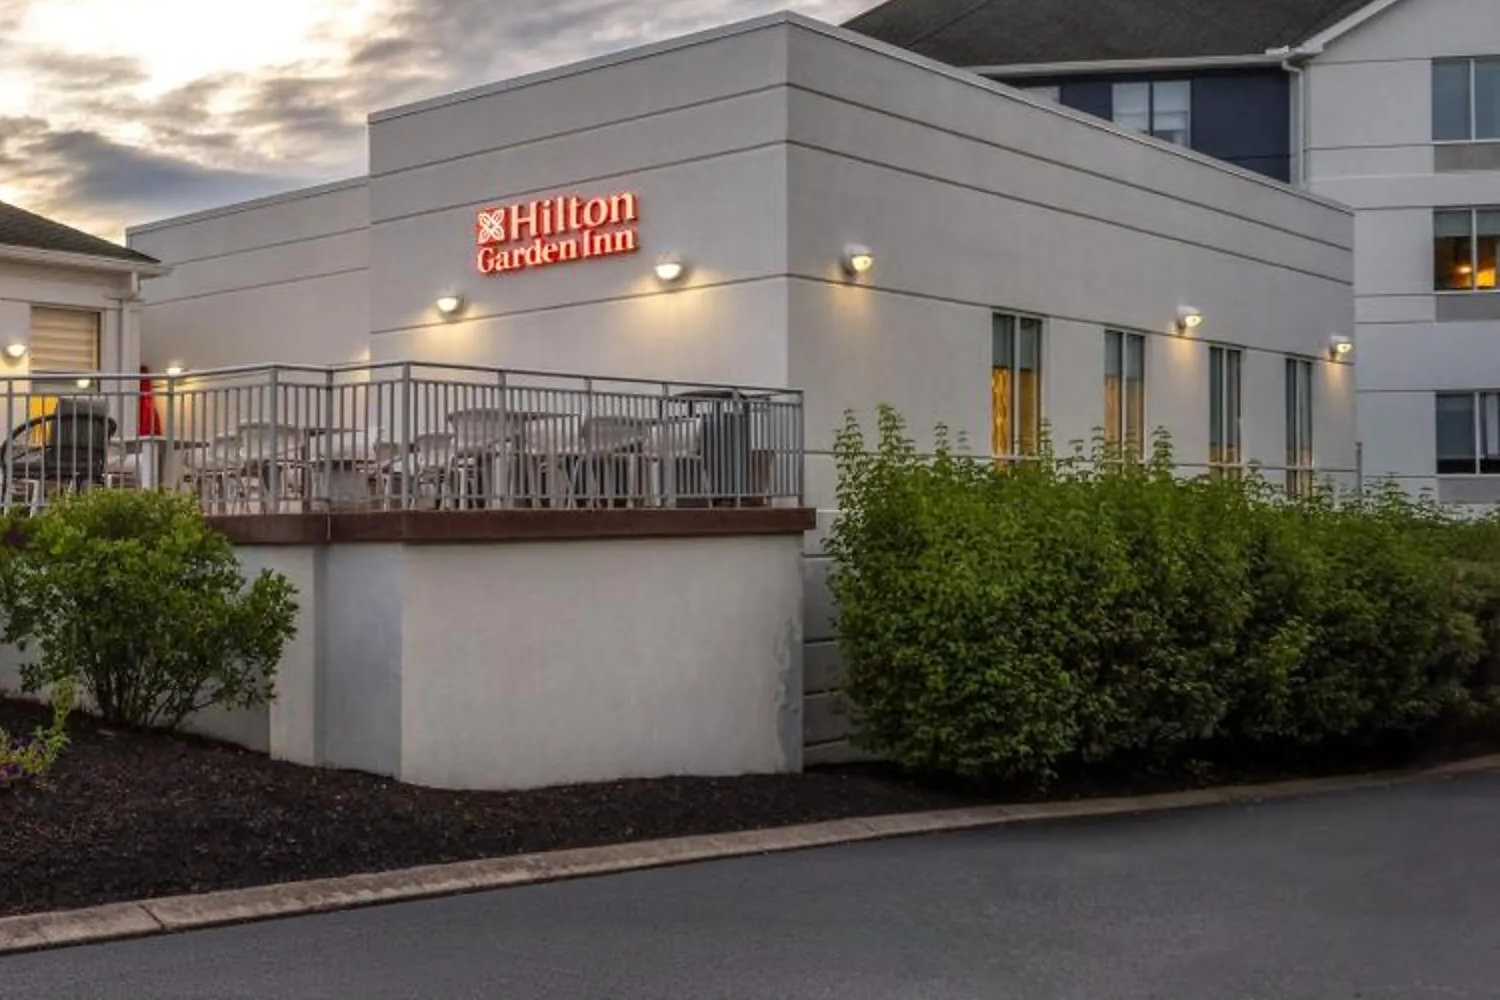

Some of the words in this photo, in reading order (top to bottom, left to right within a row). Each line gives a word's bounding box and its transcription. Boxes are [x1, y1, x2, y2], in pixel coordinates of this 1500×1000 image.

[509, 191, 636, 240] Hilton
[476, 238, 577, 273] Garden
[581, 229, 635, 257] Inn
